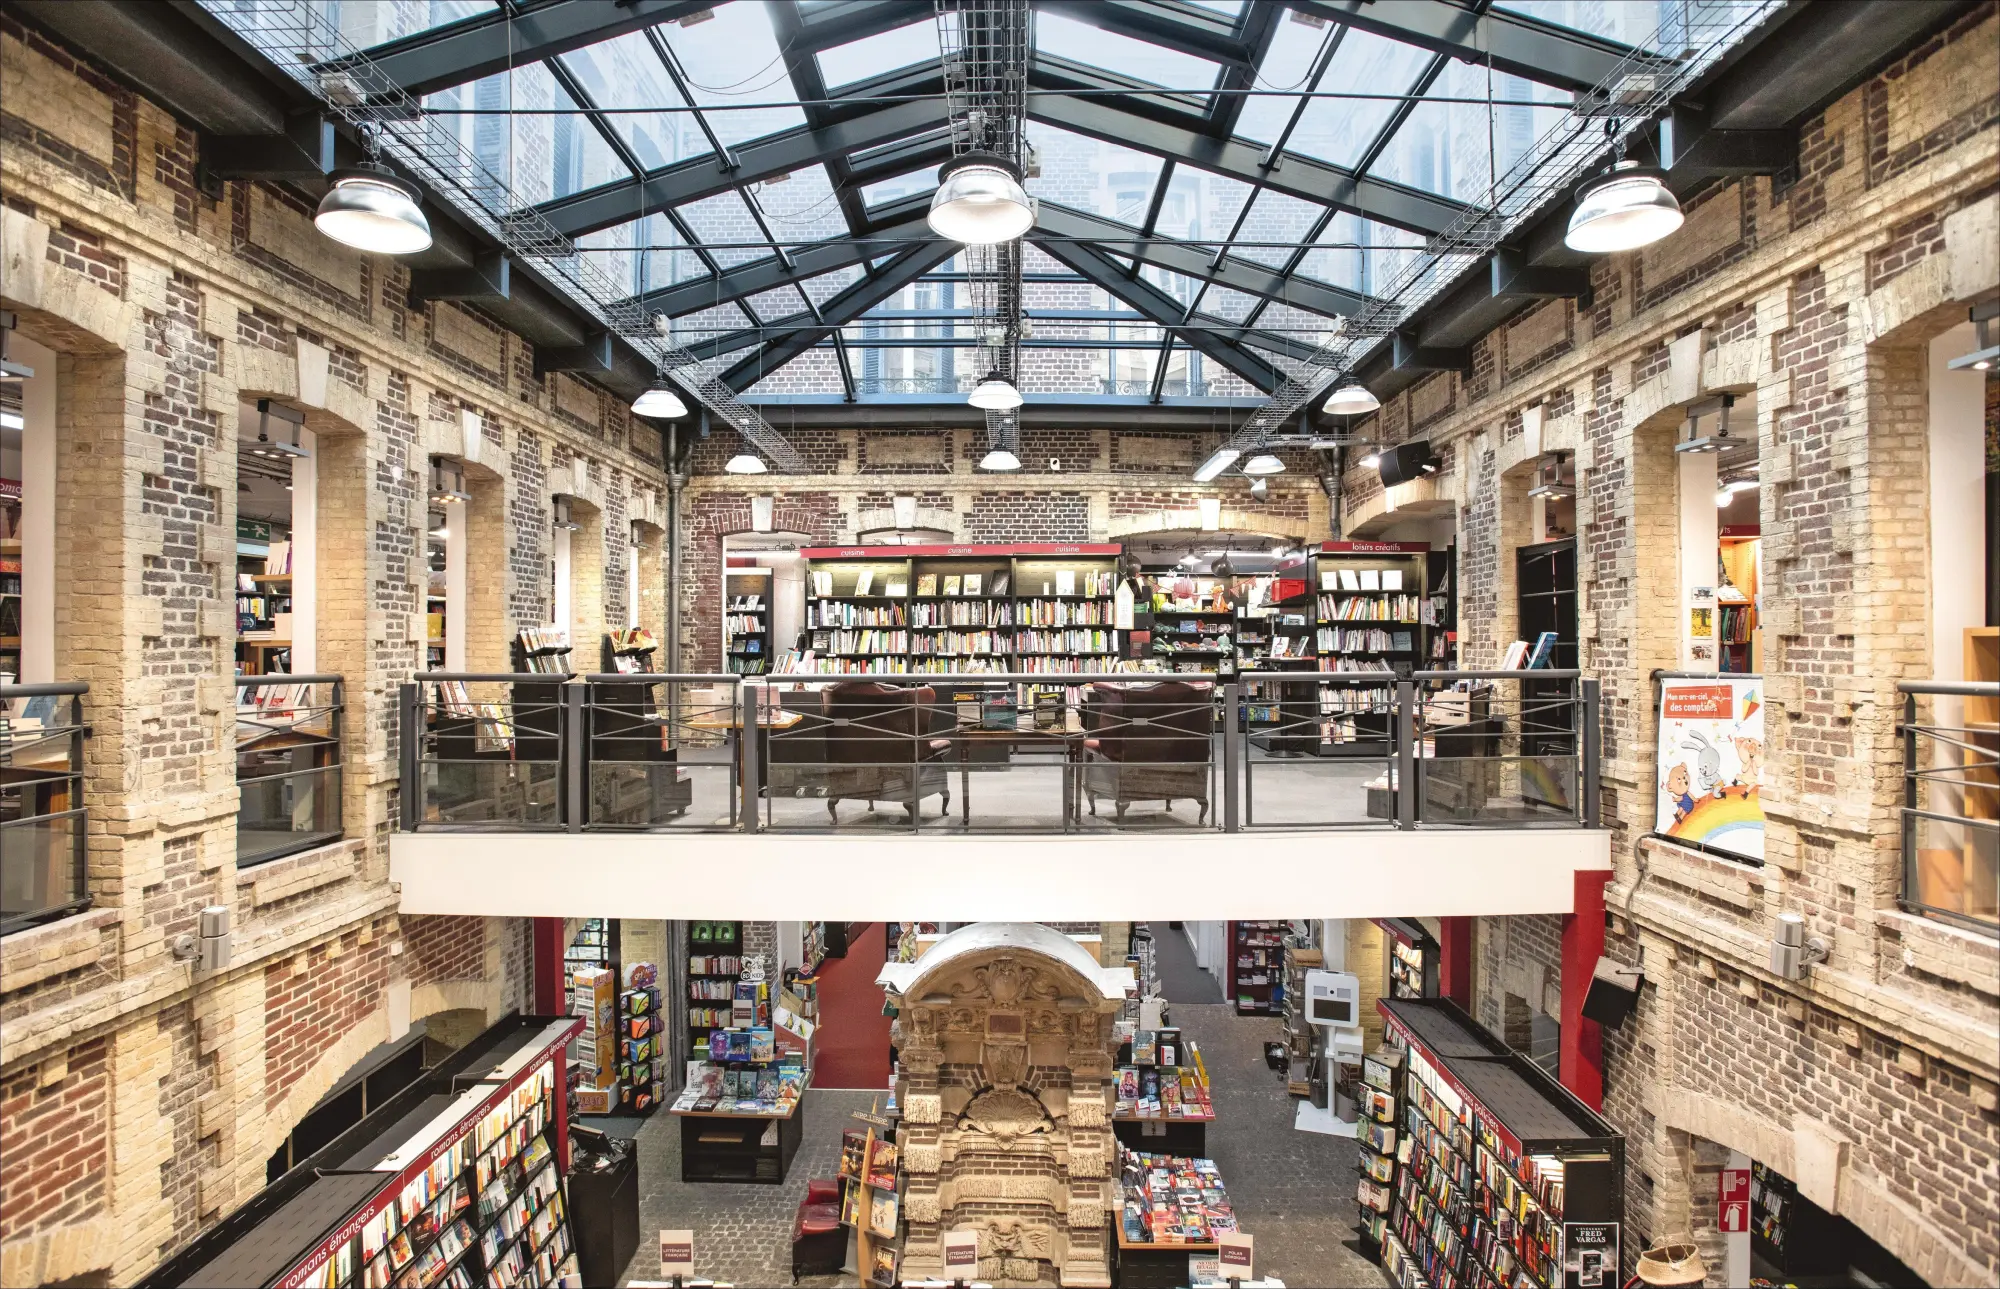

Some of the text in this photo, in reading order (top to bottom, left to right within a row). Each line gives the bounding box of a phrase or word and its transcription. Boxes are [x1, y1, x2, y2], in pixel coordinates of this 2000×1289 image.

[947, 547, 973, 555] cuisine
[1055, 546, 1080, 554] cuisine
[1352, 542, 1400, 551] loisirs créatifs
[840, 549, 865, 557] cuisine
[1679, 692, 1708, 700] arc-en-ciel
[1670, 703, 1682, 712] des
[1388, 1014, 1422, 1053] romans policiers
[529, 1031, 572, 1074] romans étrangers
[1454, 1082, 1499, 1133] romans policiers
[430, 1103, 490, 1160] romans étrangers
[285, 1205, 375, 1289] romans étrangers
